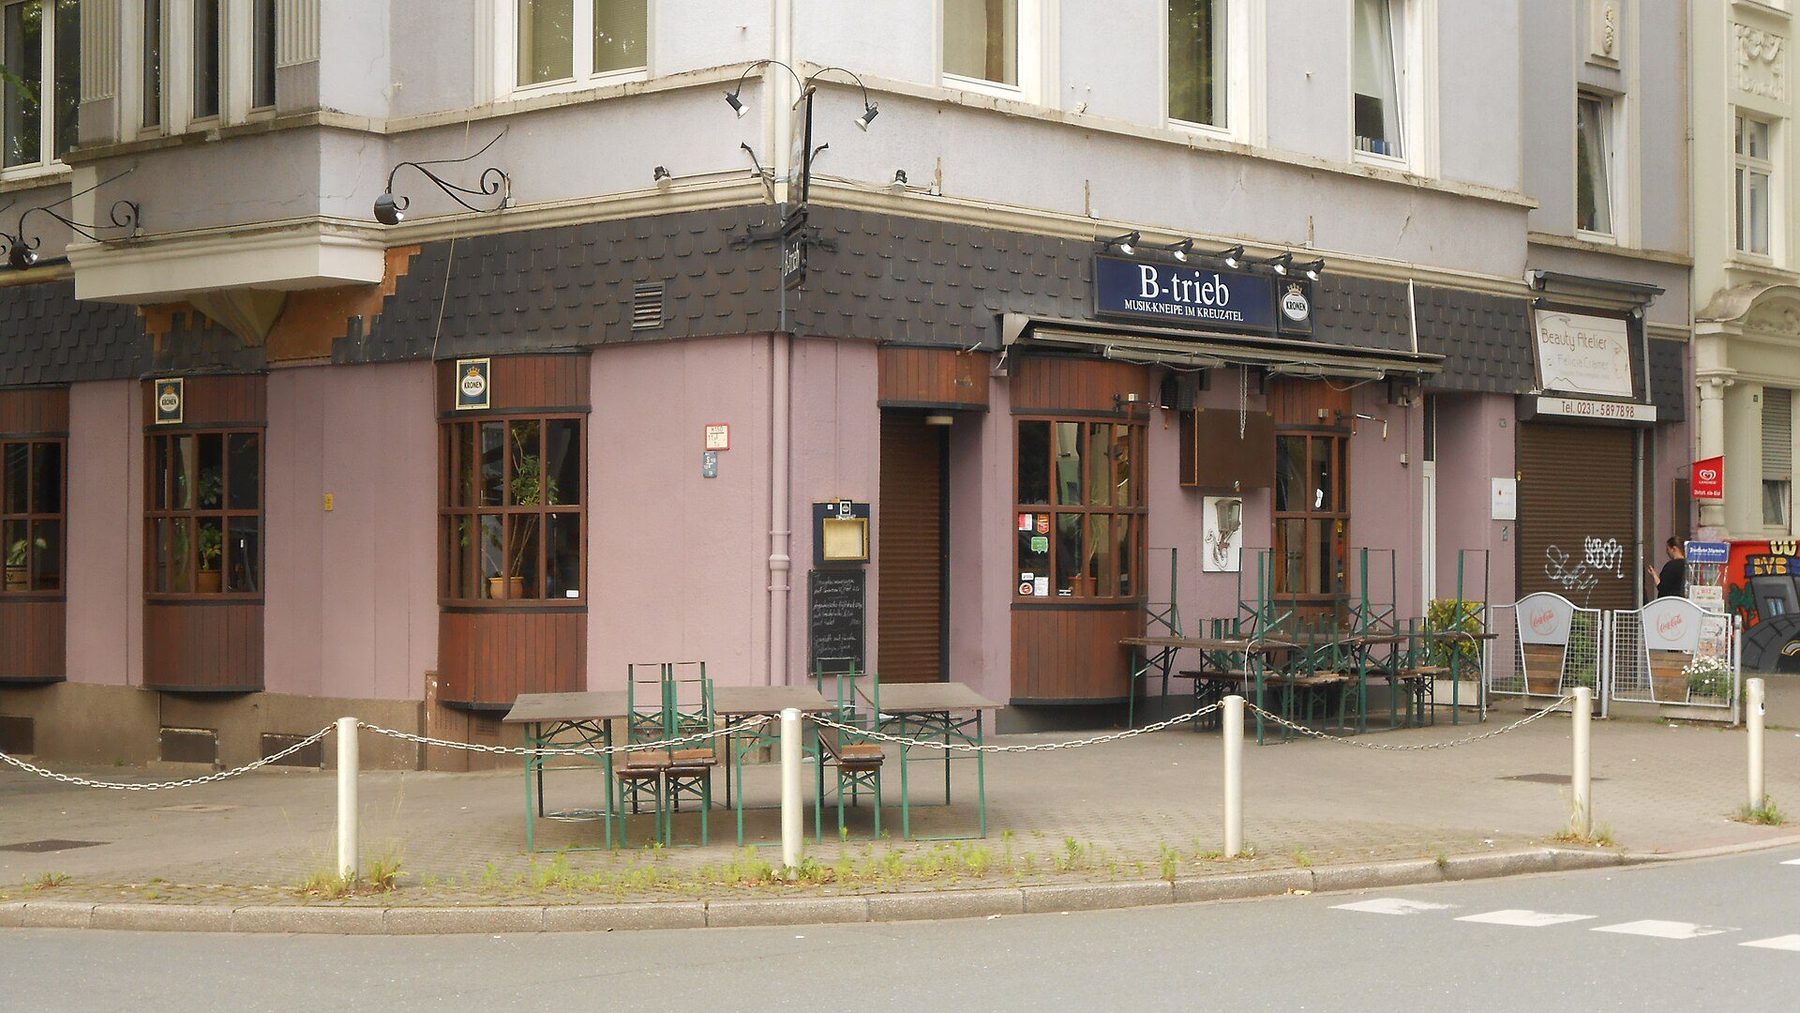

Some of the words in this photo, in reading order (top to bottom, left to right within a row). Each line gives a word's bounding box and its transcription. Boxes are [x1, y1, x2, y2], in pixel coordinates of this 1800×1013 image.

[1137, 264, 1230, 307] B-trieb
[1124, 299, 1184, 315] MUSIK-KNEIPE
[1185, 306, 1196, 317] IM
[1286, 301, 1307, 312] KRONEN
[1540, 327, 1575, 352] Beauty
[1577, 332, 1607, 350] Atelier
[464, 381, 483, 389] KRONEN
[1561, 401, 1575, 414] Tel.
